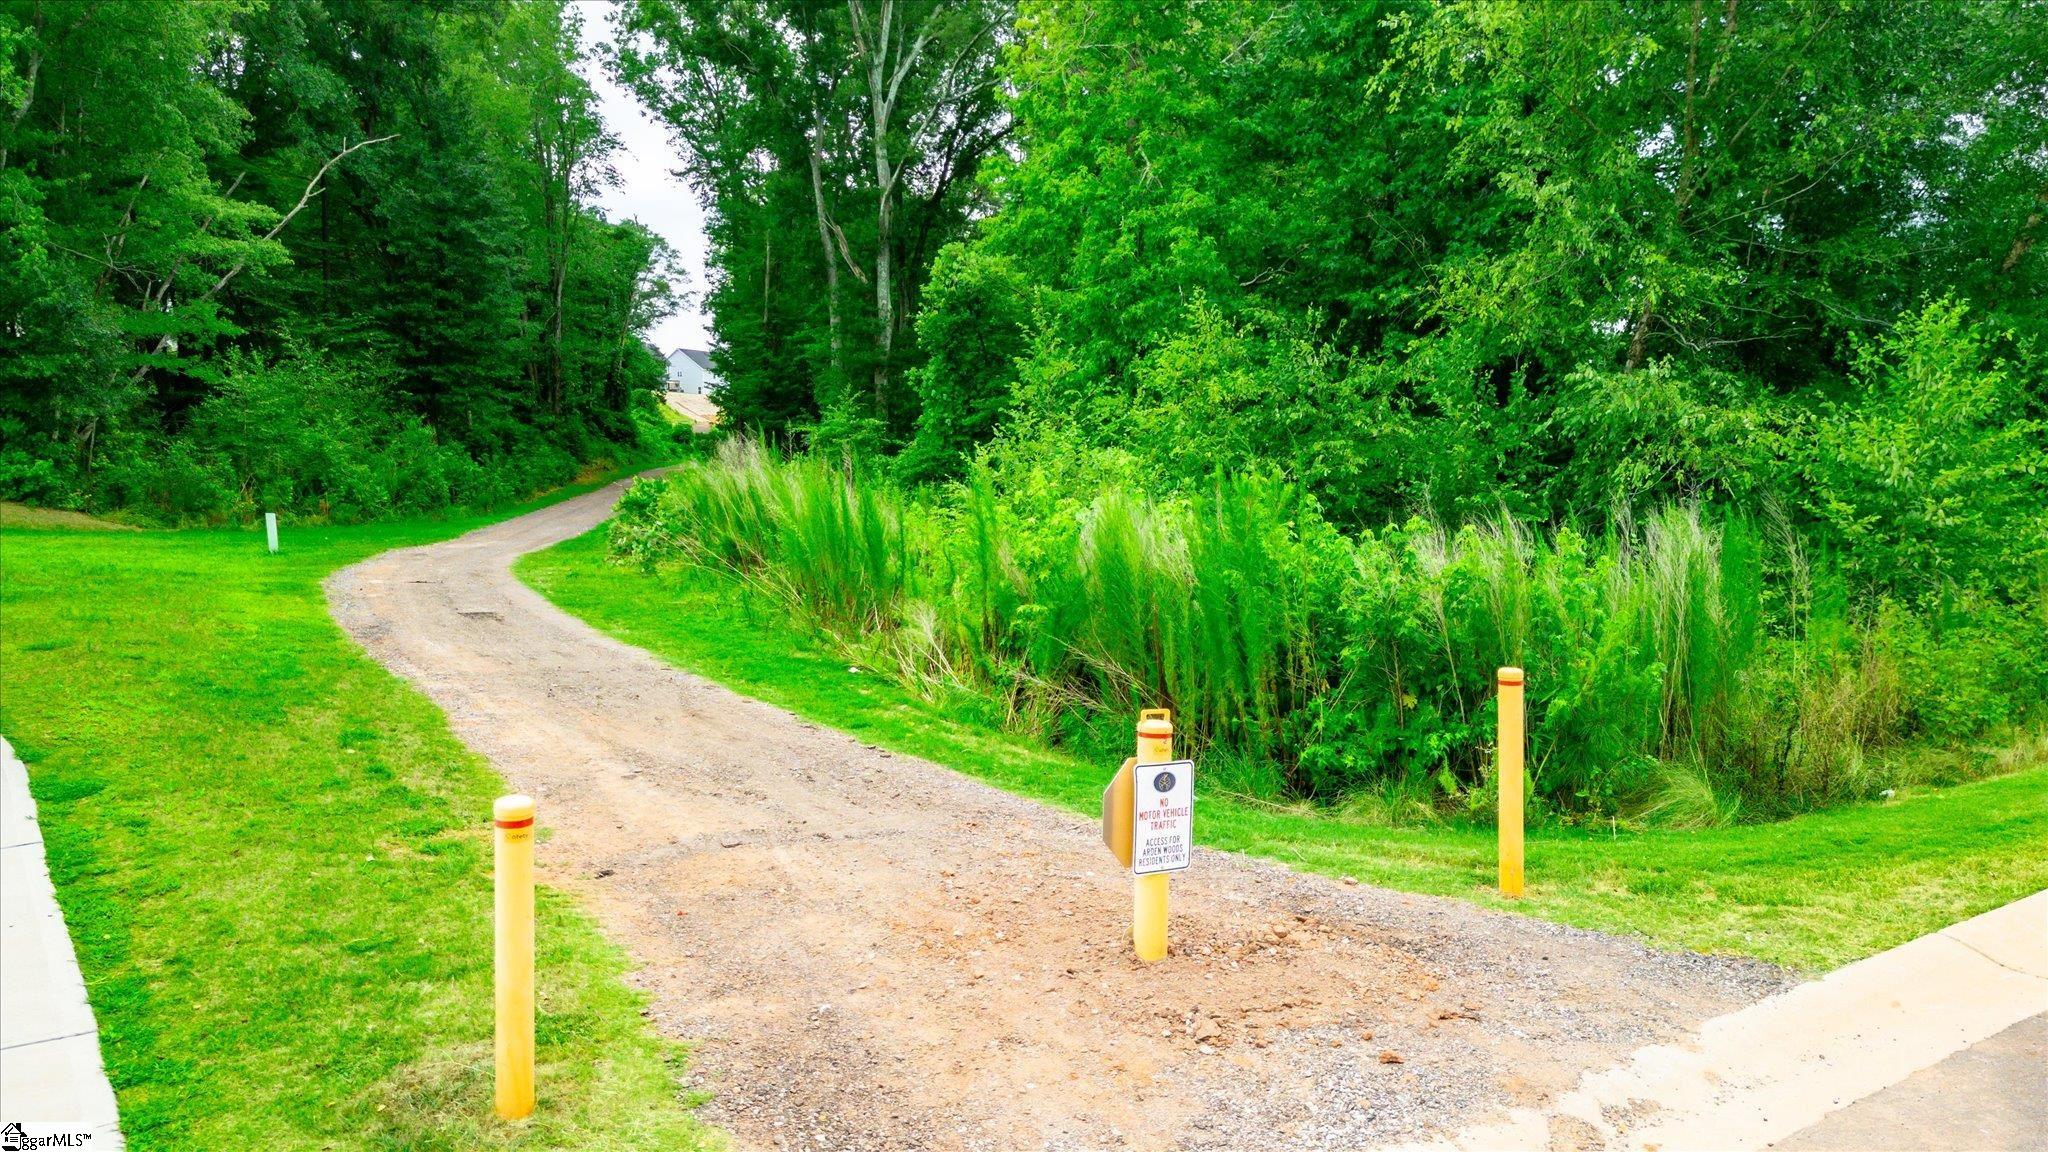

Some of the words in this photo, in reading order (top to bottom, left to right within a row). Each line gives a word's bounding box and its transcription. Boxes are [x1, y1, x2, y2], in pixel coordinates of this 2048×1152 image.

[1160, 798, 1168, 807] NO
[1139, 810, 1160, 821] MOTOR
[1163, 807, 1188, 817] VEHICLE
[1150, 819, 1176, 830] TRAFFIC
[1146, 837, 1168, 846] ACCESS
[1169, 835, 1180, 844] FOR
[1142, 846, 1162, 856] ARDEN
[1164, 844, 1183, 854] WOODS
[1138, 855, 1170, 866] RESIDENTS
[1170, 853, 1186, 863] ONLY
